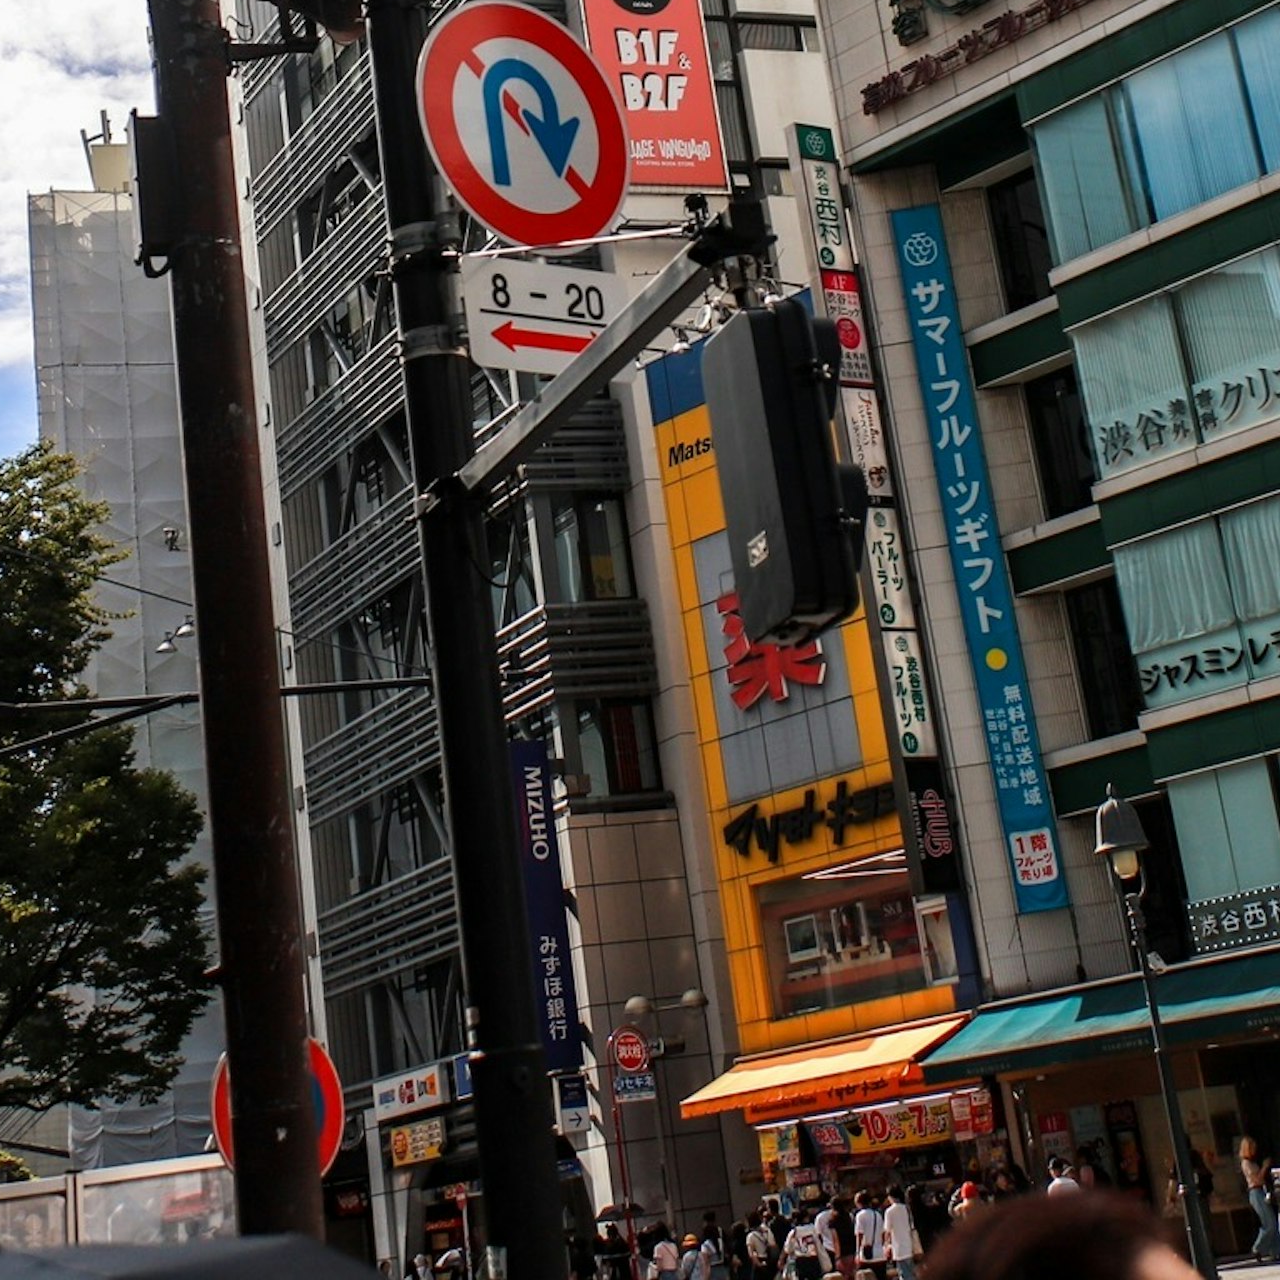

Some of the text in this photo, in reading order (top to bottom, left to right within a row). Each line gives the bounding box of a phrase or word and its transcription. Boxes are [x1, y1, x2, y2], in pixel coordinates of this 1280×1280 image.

[614, 28, 680, 67] B1F
[621, 72, 689, 112] B2F
[491, 273, 512, 309] 8
[565, 284, 606, 320] 20
[668, 437, 715, 468] Mats
[910, 277, 1004, 635] サマーフルーツギフト
[871, 539, 889, 601] パーラー
[883, 531, 905, 593] フルーツ
[892, 665, 912, 728] フルーツ
[906, 656, 927, 722] 渋谷西村
[1002, 684, 1044, 807] 無料配送地域
[523, 766, 550, 862] MIZUHO
[1015, 853, 1053, 867] フルーツ
[1020, 866, 1055, 881] 売り場
[539, 935, 569, 1043] みずほ銀行
